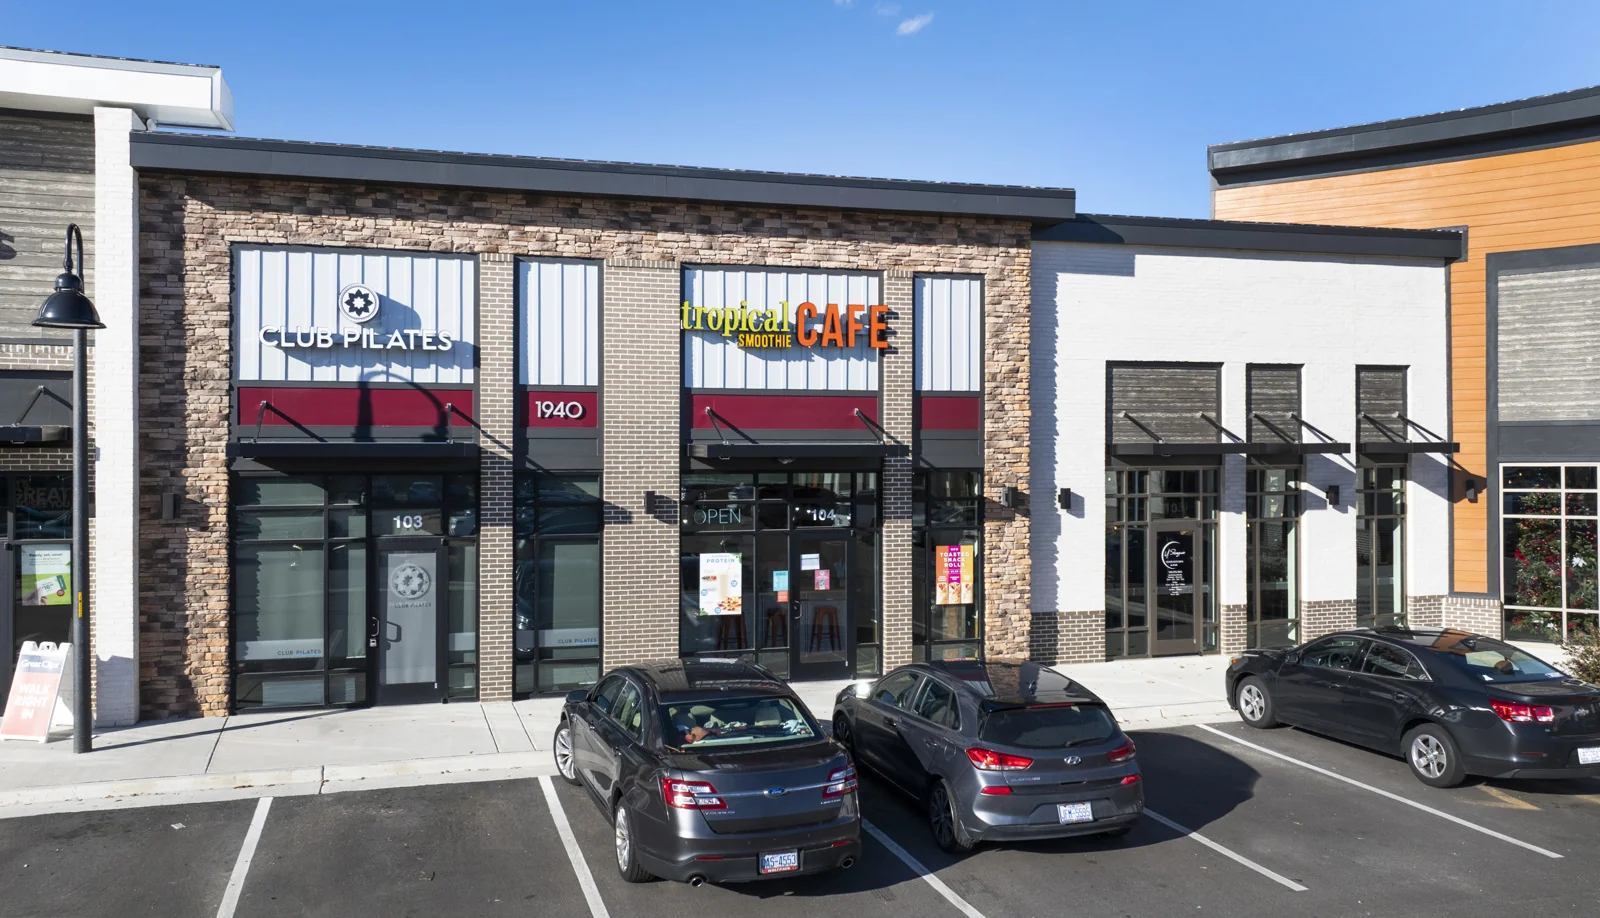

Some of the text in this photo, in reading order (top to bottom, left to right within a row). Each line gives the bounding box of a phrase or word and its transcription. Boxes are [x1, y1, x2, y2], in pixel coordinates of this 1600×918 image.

[681, 300, 889, 349] tropical CAFE
[259, 325, 452, 351] CLUB PILATES
[737, 333, 792, 348] SMOOTHIE
[535, 401, 583, 418] 1940
[393, 515, 423, 528] 103
[693, 508, 741, 525] OPEN
[811, 508, 835, 521] 104
[20, 683, 52, 693] WALK
[20, 708, 35, 719] IN
